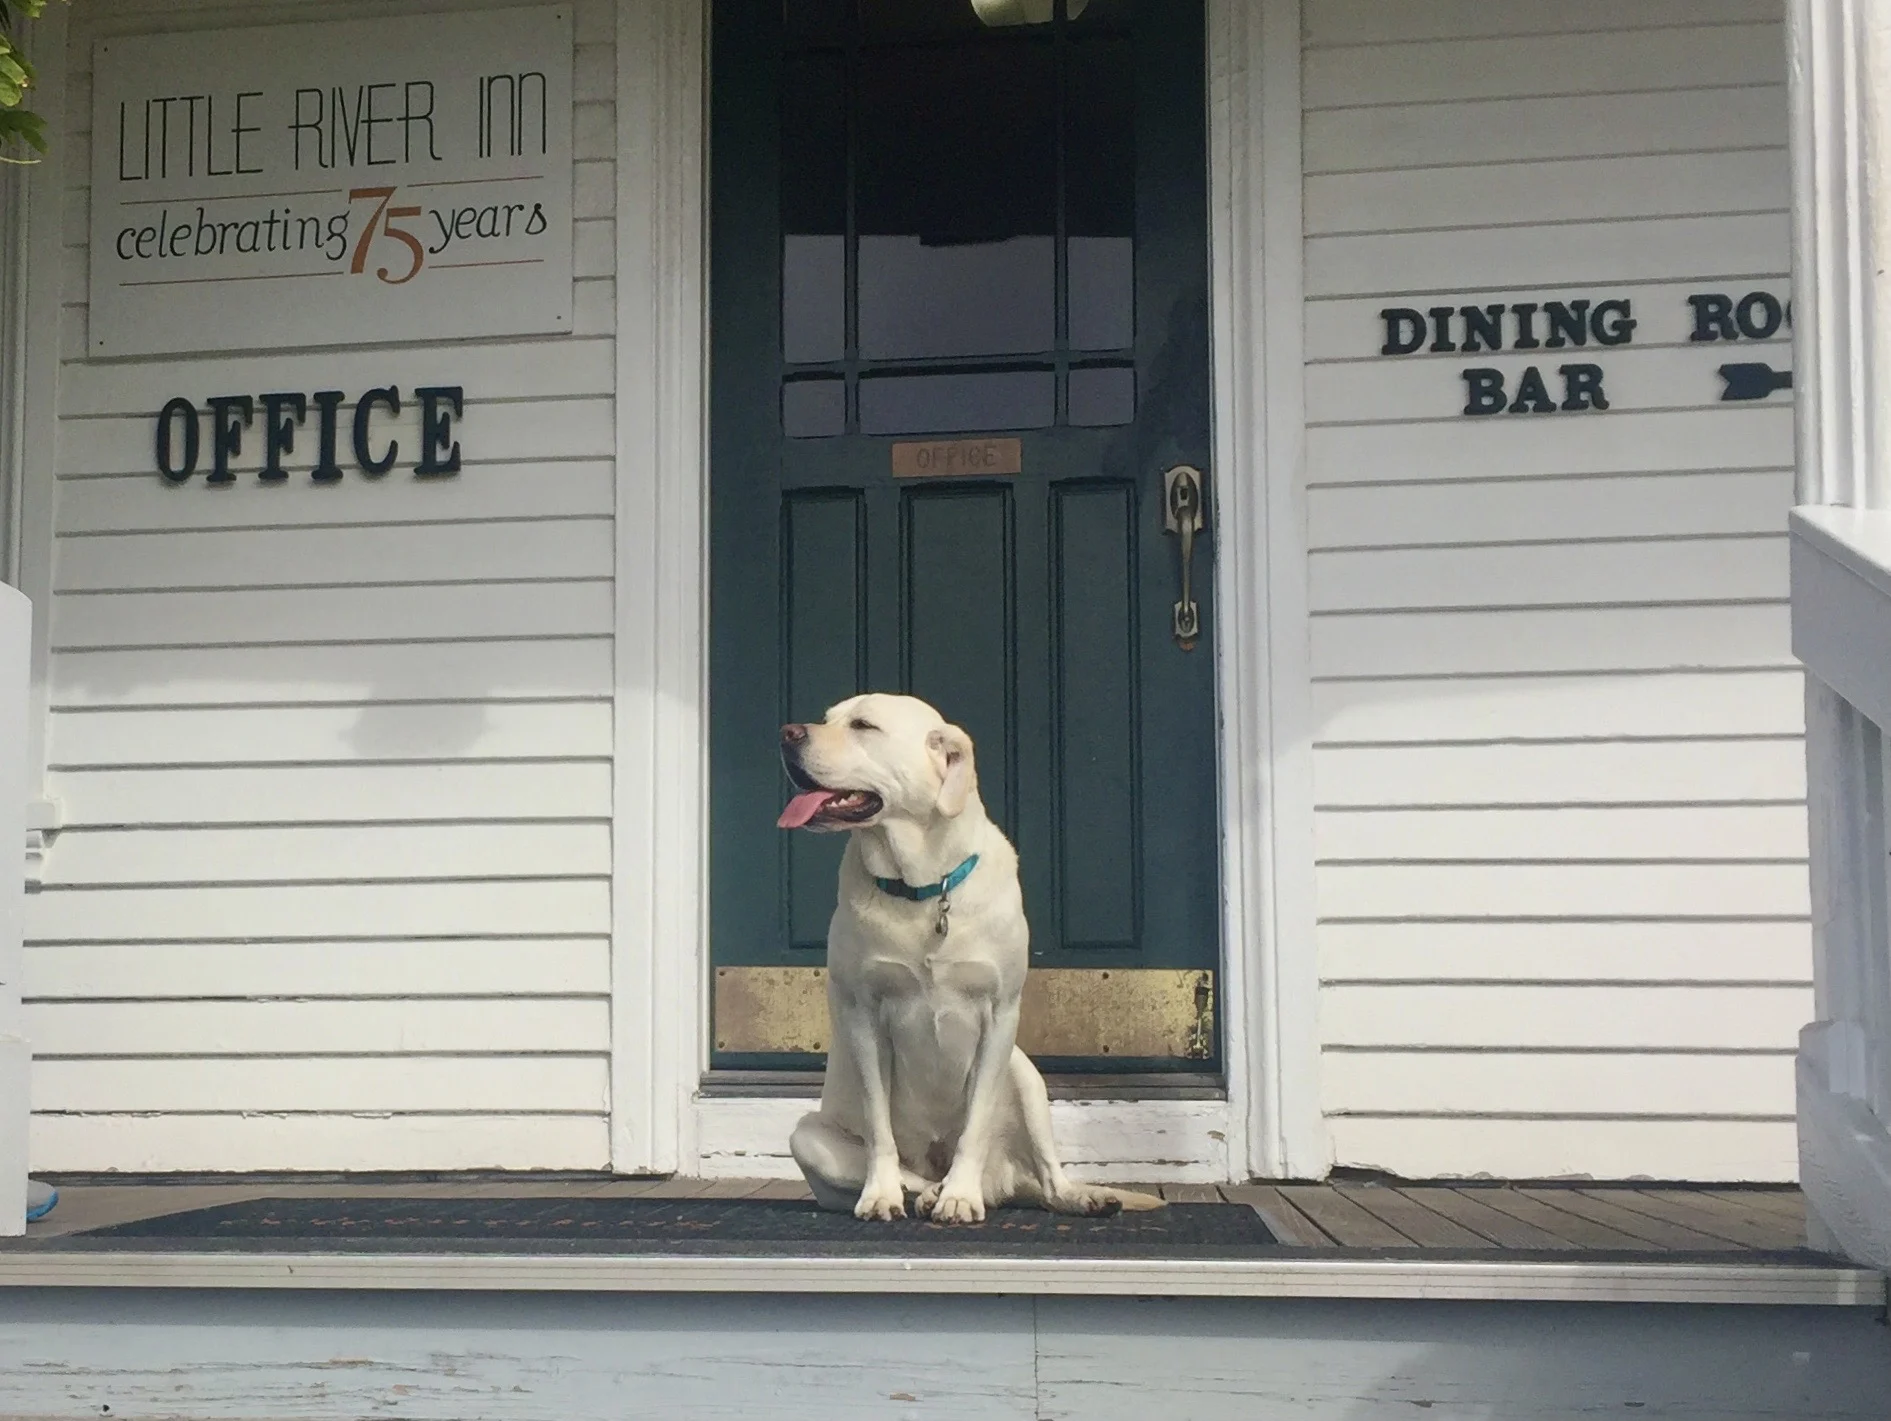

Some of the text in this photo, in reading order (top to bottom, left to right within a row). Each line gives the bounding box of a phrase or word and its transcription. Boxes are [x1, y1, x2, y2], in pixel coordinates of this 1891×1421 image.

[119, 93, 264, 181] LITTLE
[287, 81, 443, 171] RIVER
[116, 187, 548, 285] celebrating 75 years
[1380, 292, 1792, 355] DINING RO
[1462, 363, 1610, 416] BAR
[156, 385, 464, 482] OFFICE
[916, 445, 997, 469] OFFICE
